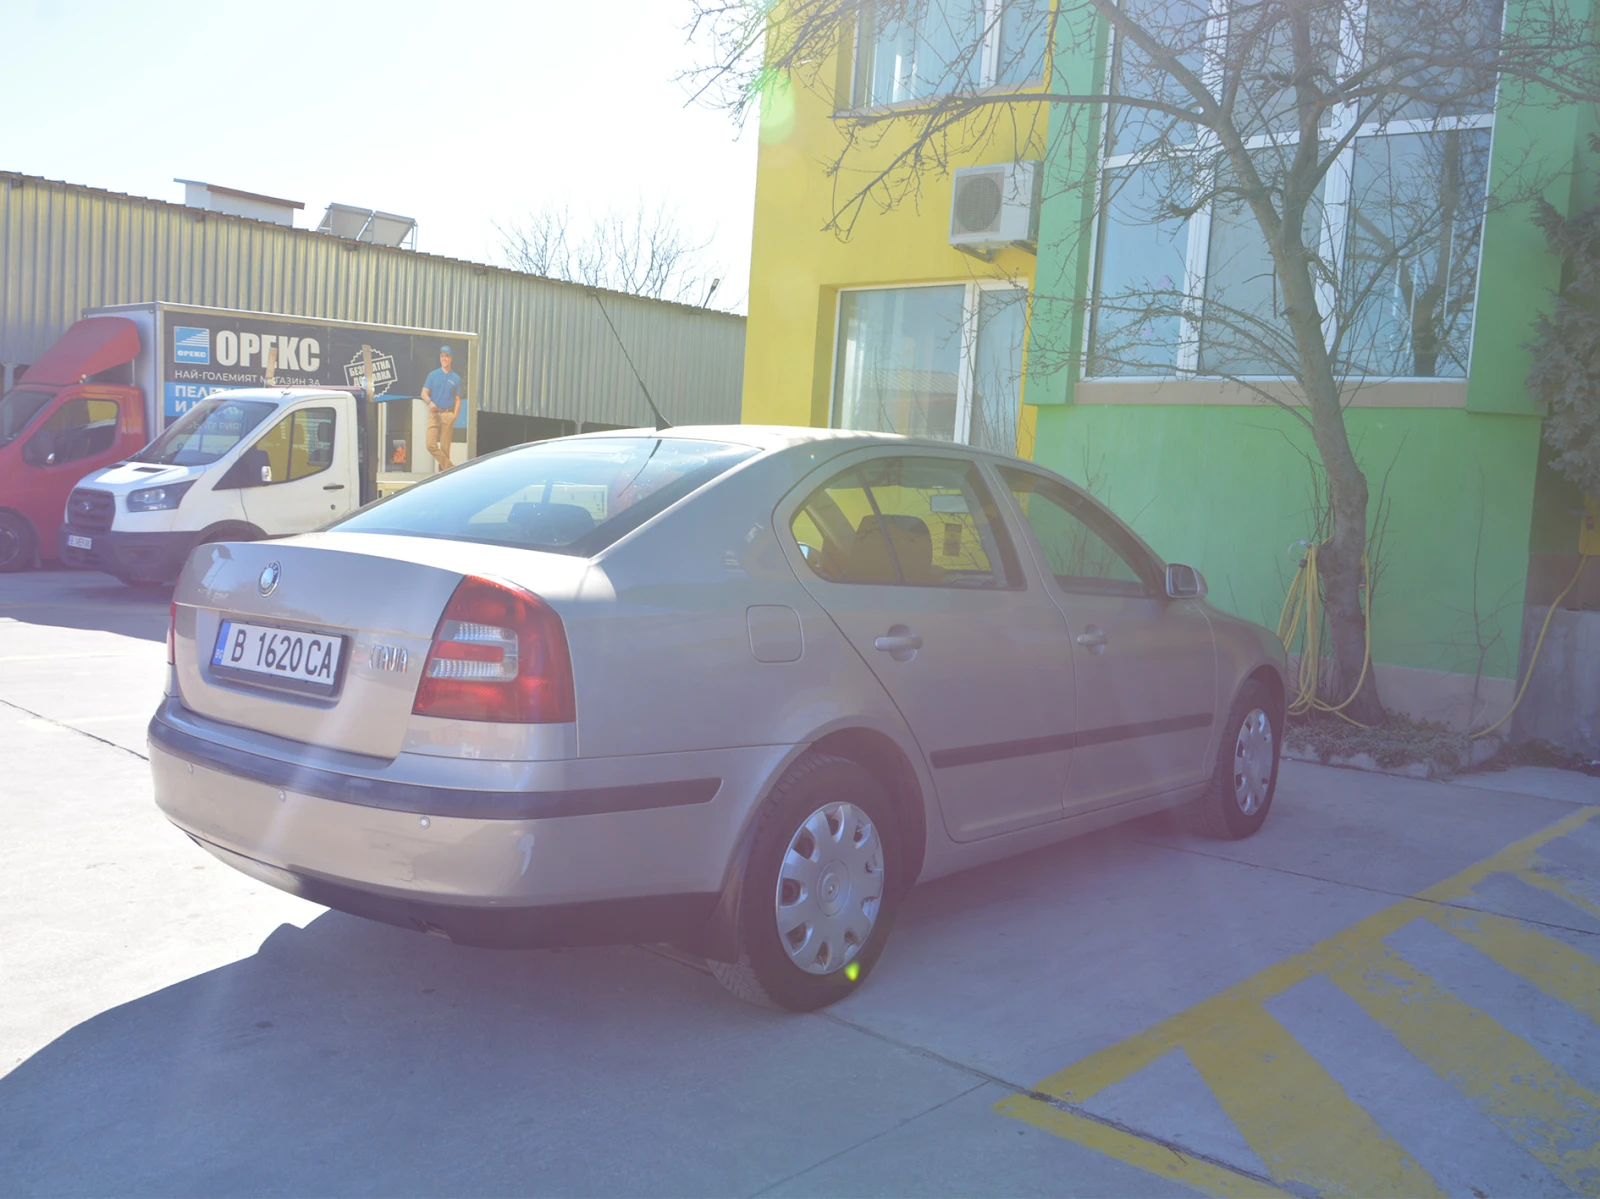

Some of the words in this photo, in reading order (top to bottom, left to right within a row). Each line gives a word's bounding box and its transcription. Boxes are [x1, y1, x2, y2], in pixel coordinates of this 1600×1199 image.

[177, 349, 207, 358] ОРЕКС
[216, 330, 321, 373] ОРЕКС
[348, 360, 391, 377] БЕЗАТНА
[174, 369, 258, 383] НАЙ-ГОЛЕМИЯТ
[260, 375, 306, 386] МГАЗИН
[308, 378, 321, 387] ЗА
[353, 370, 392, 387] ДОАВКА
[175, 400, 187, 412] И
[231, 629, 247, 662] B
